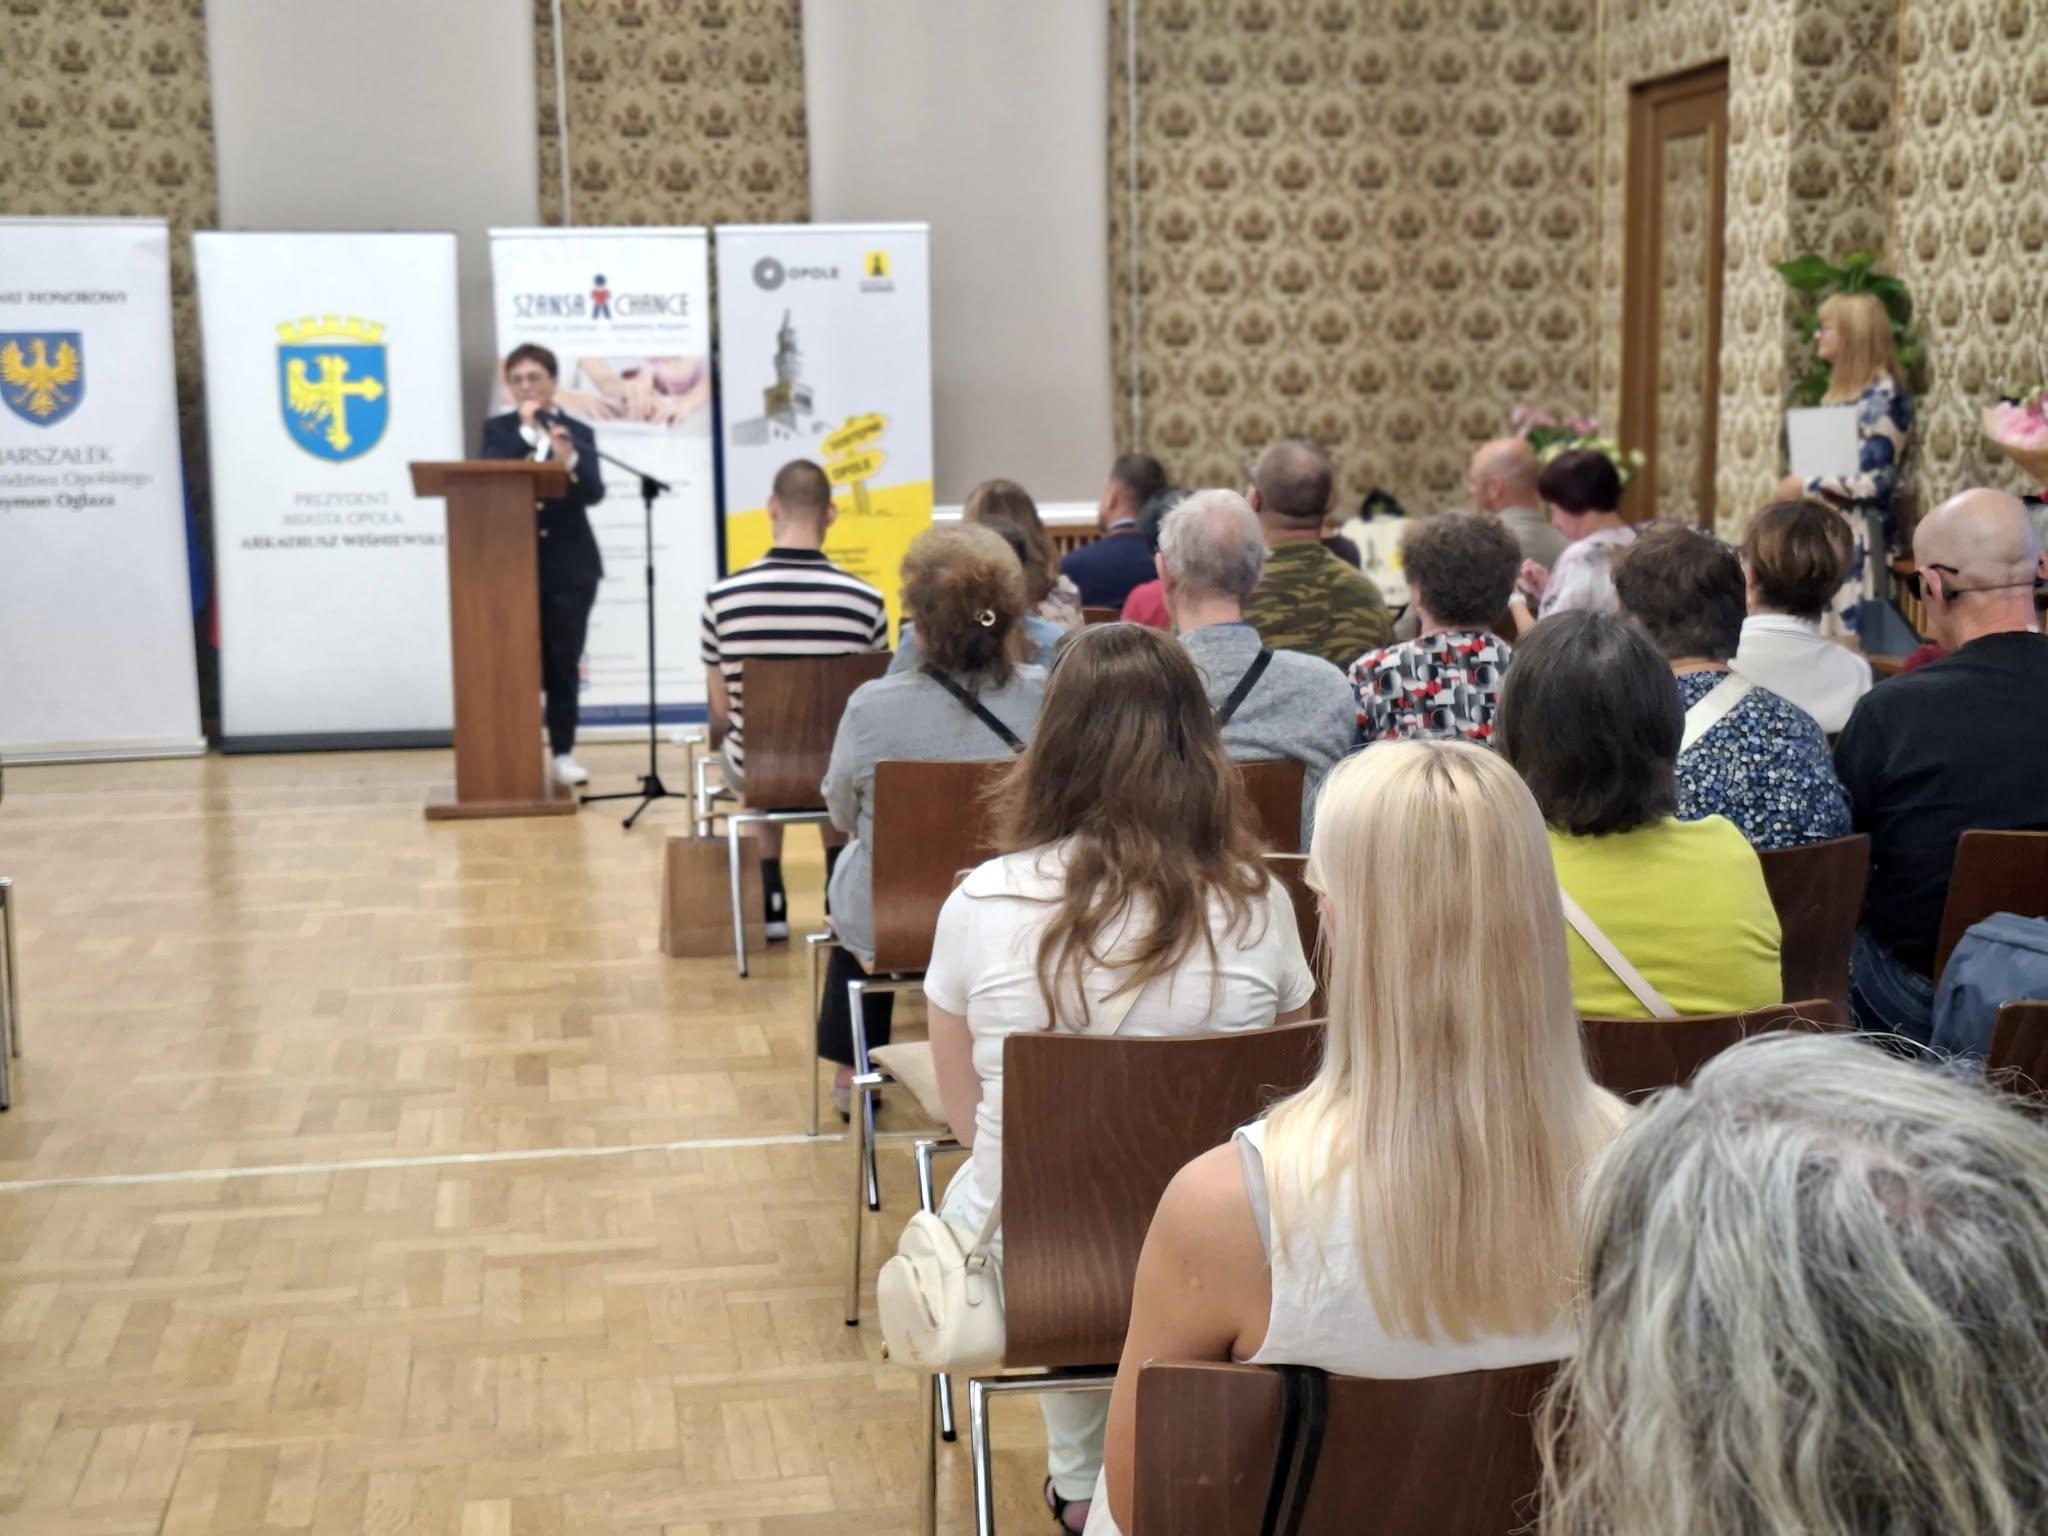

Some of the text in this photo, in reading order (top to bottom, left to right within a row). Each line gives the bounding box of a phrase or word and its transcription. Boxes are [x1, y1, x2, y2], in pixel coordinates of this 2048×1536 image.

[788, 267, 839, 280] OPOLE
[513, 292, 689, 318] SZANSA CHANCE
[832, 457, 871, 480] OPOLE
[294, 492, 389, 505] PREZYDENT
